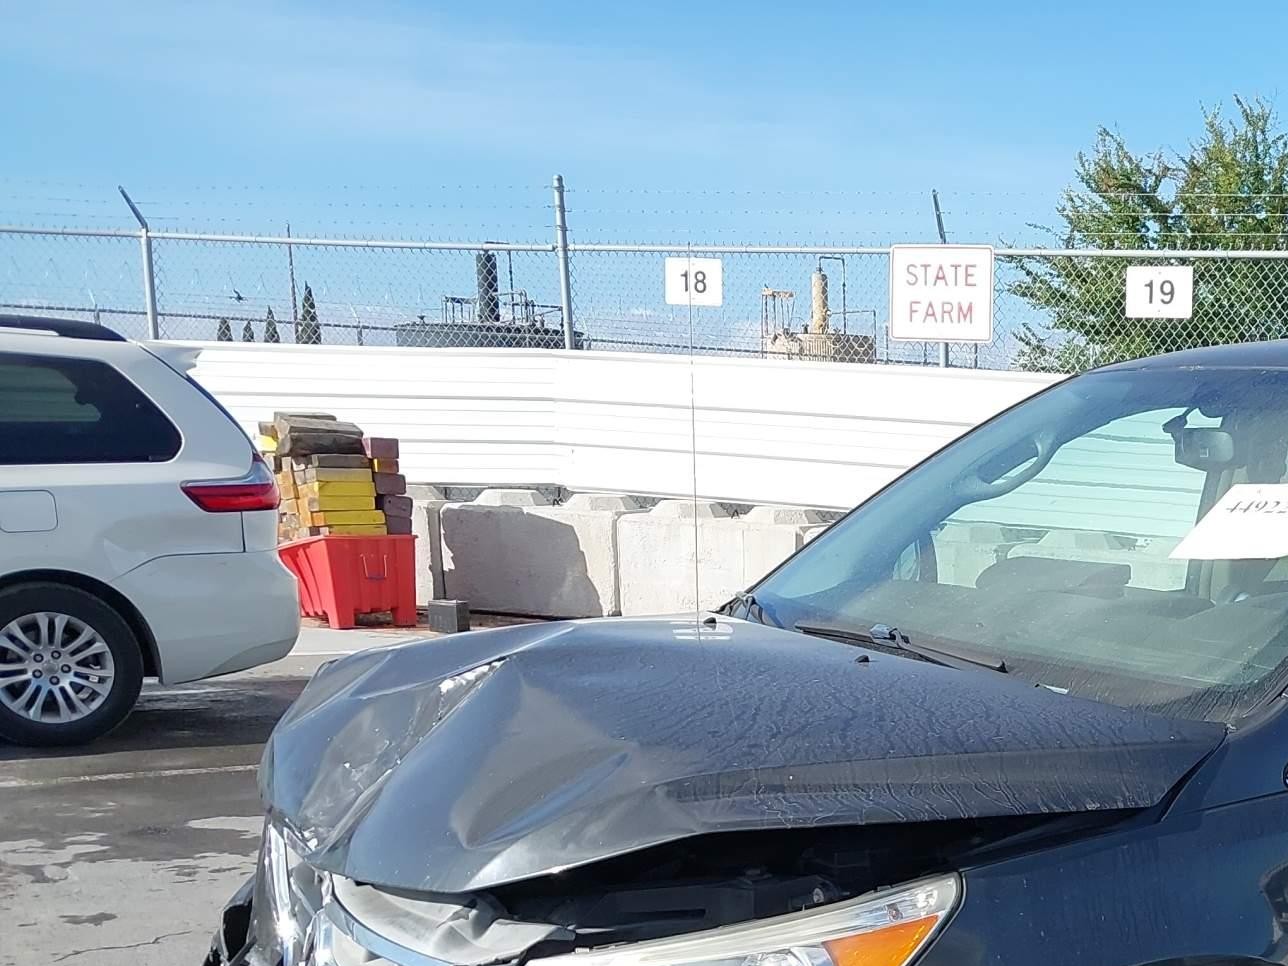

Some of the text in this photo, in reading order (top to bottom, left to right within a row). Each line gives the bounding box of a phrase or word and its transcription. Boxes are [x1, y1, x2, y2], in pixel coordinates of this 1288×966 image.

[680, 270, 707, 294] 18
[906, 263, 977, 287] STATE
[1143, 279, 1175, 305] 19
[908, 301, 974, 324] FARM
